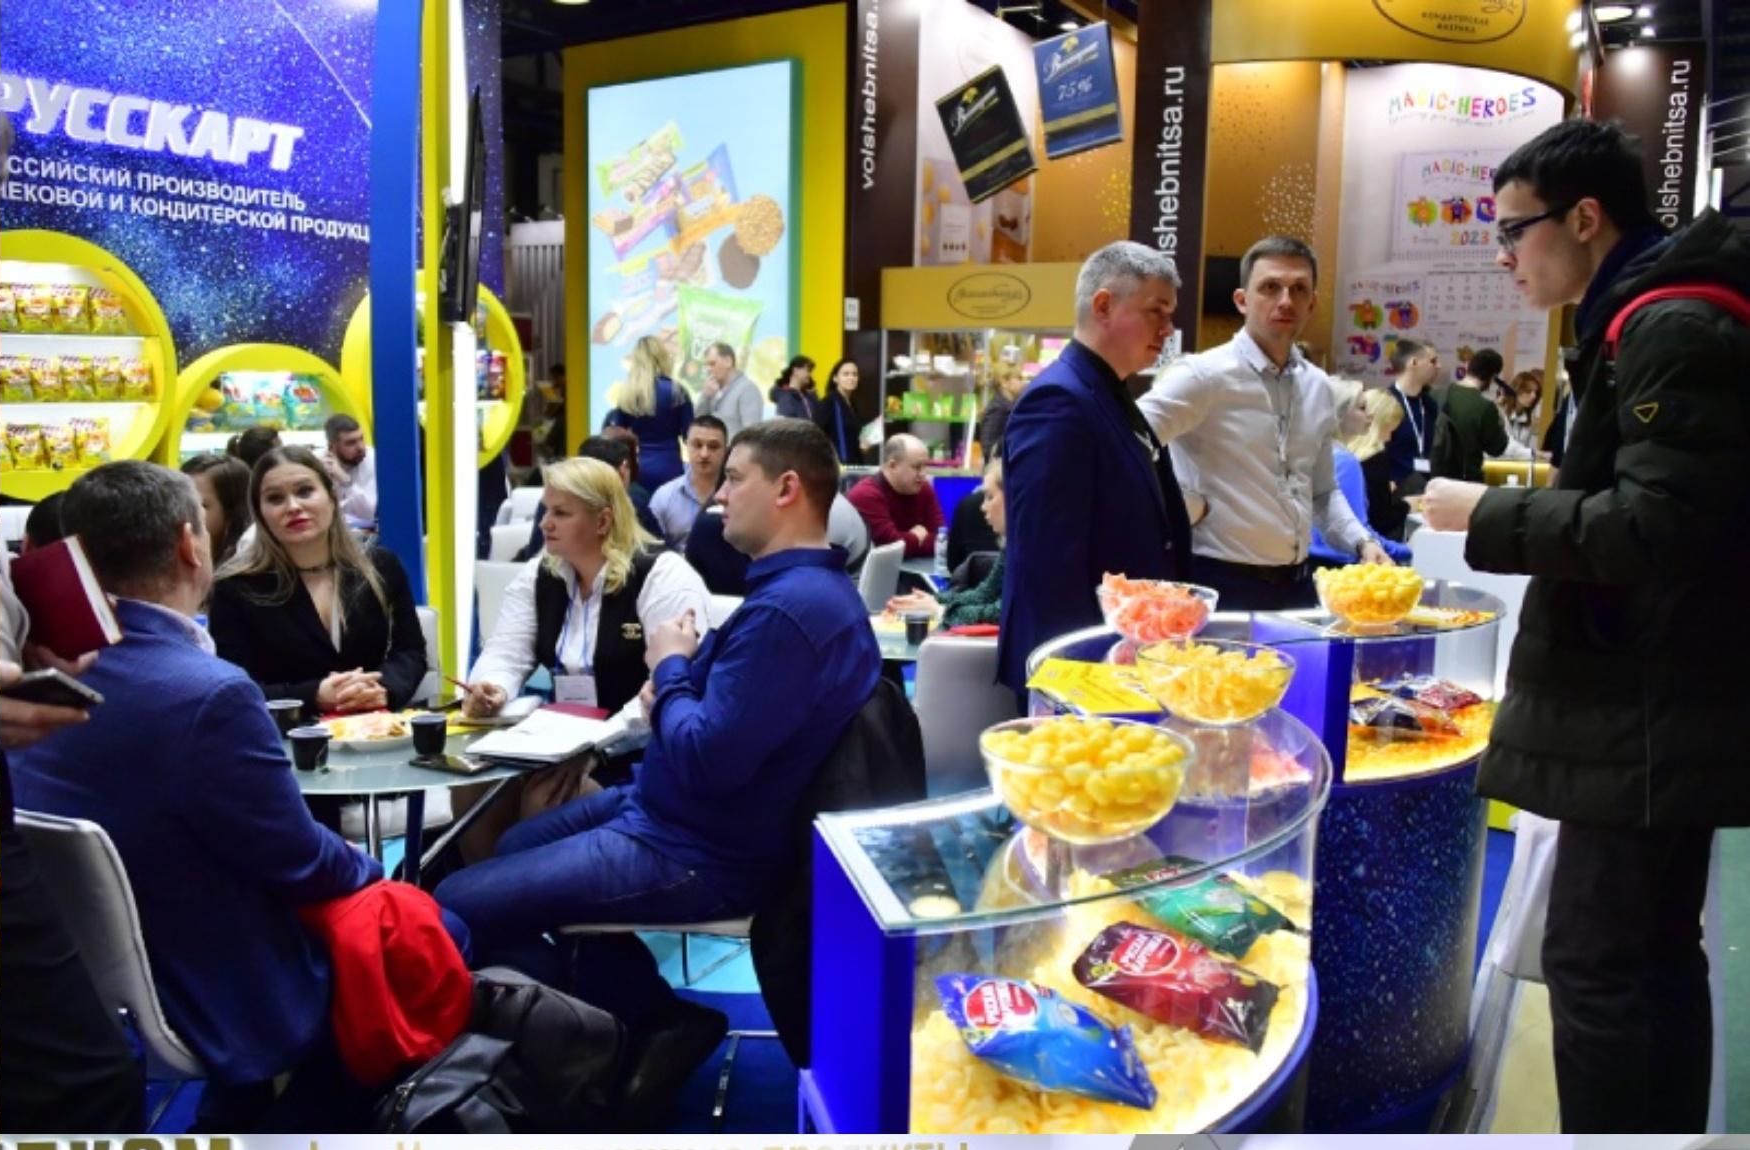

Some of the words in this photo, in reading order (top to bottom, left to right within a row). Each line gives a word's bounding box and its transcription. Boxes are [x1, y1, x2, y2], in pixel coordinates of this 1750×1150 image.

[859, 0, 879, 190] volshebnitsa.
[138, 173, 306, 211] ПРОИЗВОДИТЕЛЬ
[109, 195, 125, 212] И
[131, 197, 285, 231] КОНДИТЕРСКОЙ
[1450, 230, 1490, 246] 2023
